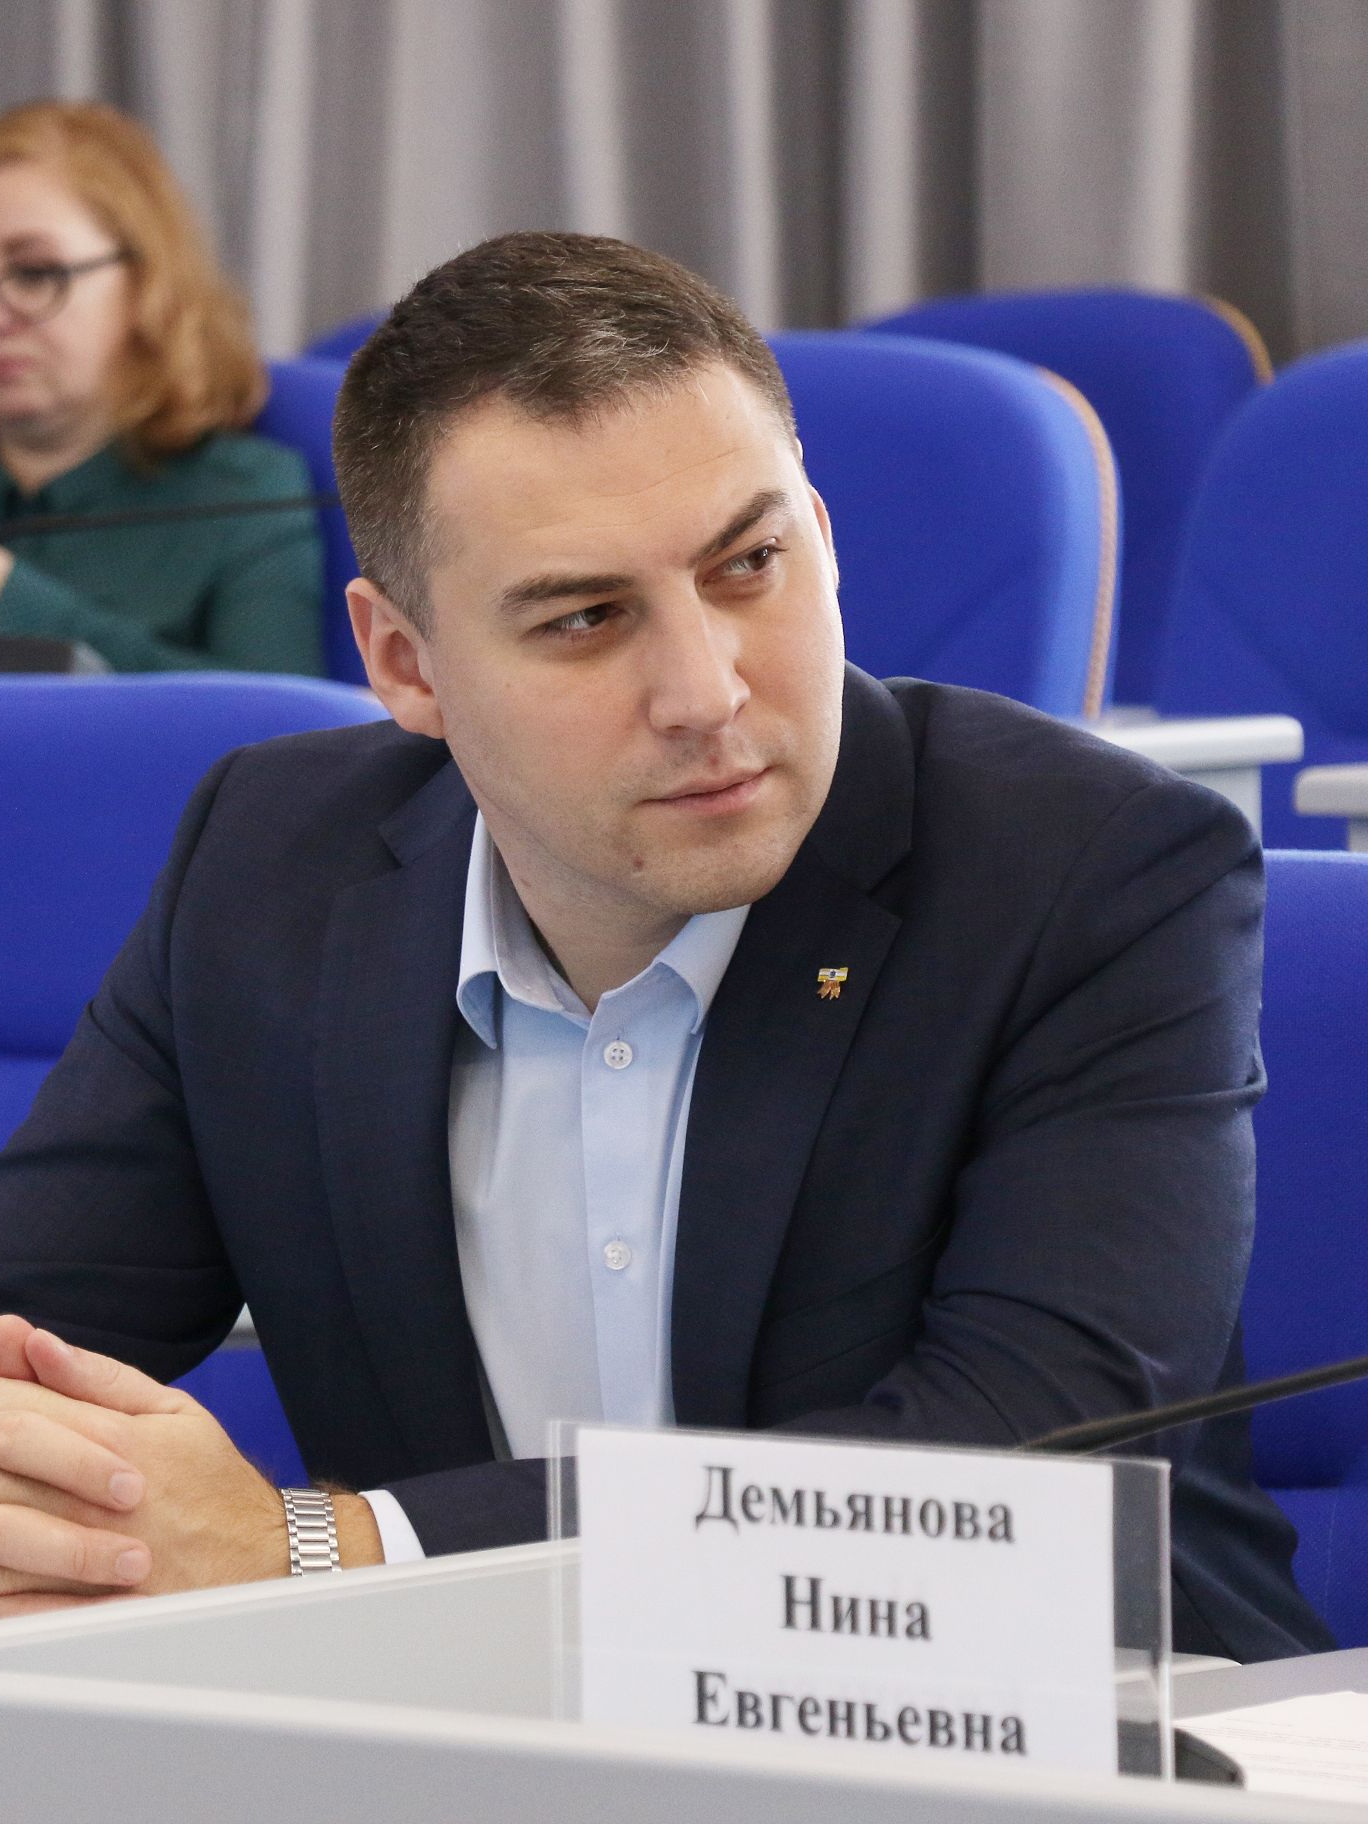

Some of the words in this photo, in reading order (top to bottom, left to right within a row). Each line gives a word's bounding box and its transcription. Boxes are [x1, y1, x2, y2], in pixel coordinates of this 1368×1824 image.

[695, 1466, 1015, 1544] Демьянова
[781, 1574, 932, 1642] Нина
[692, 1669, 1027, 1757] Евгеньевна
